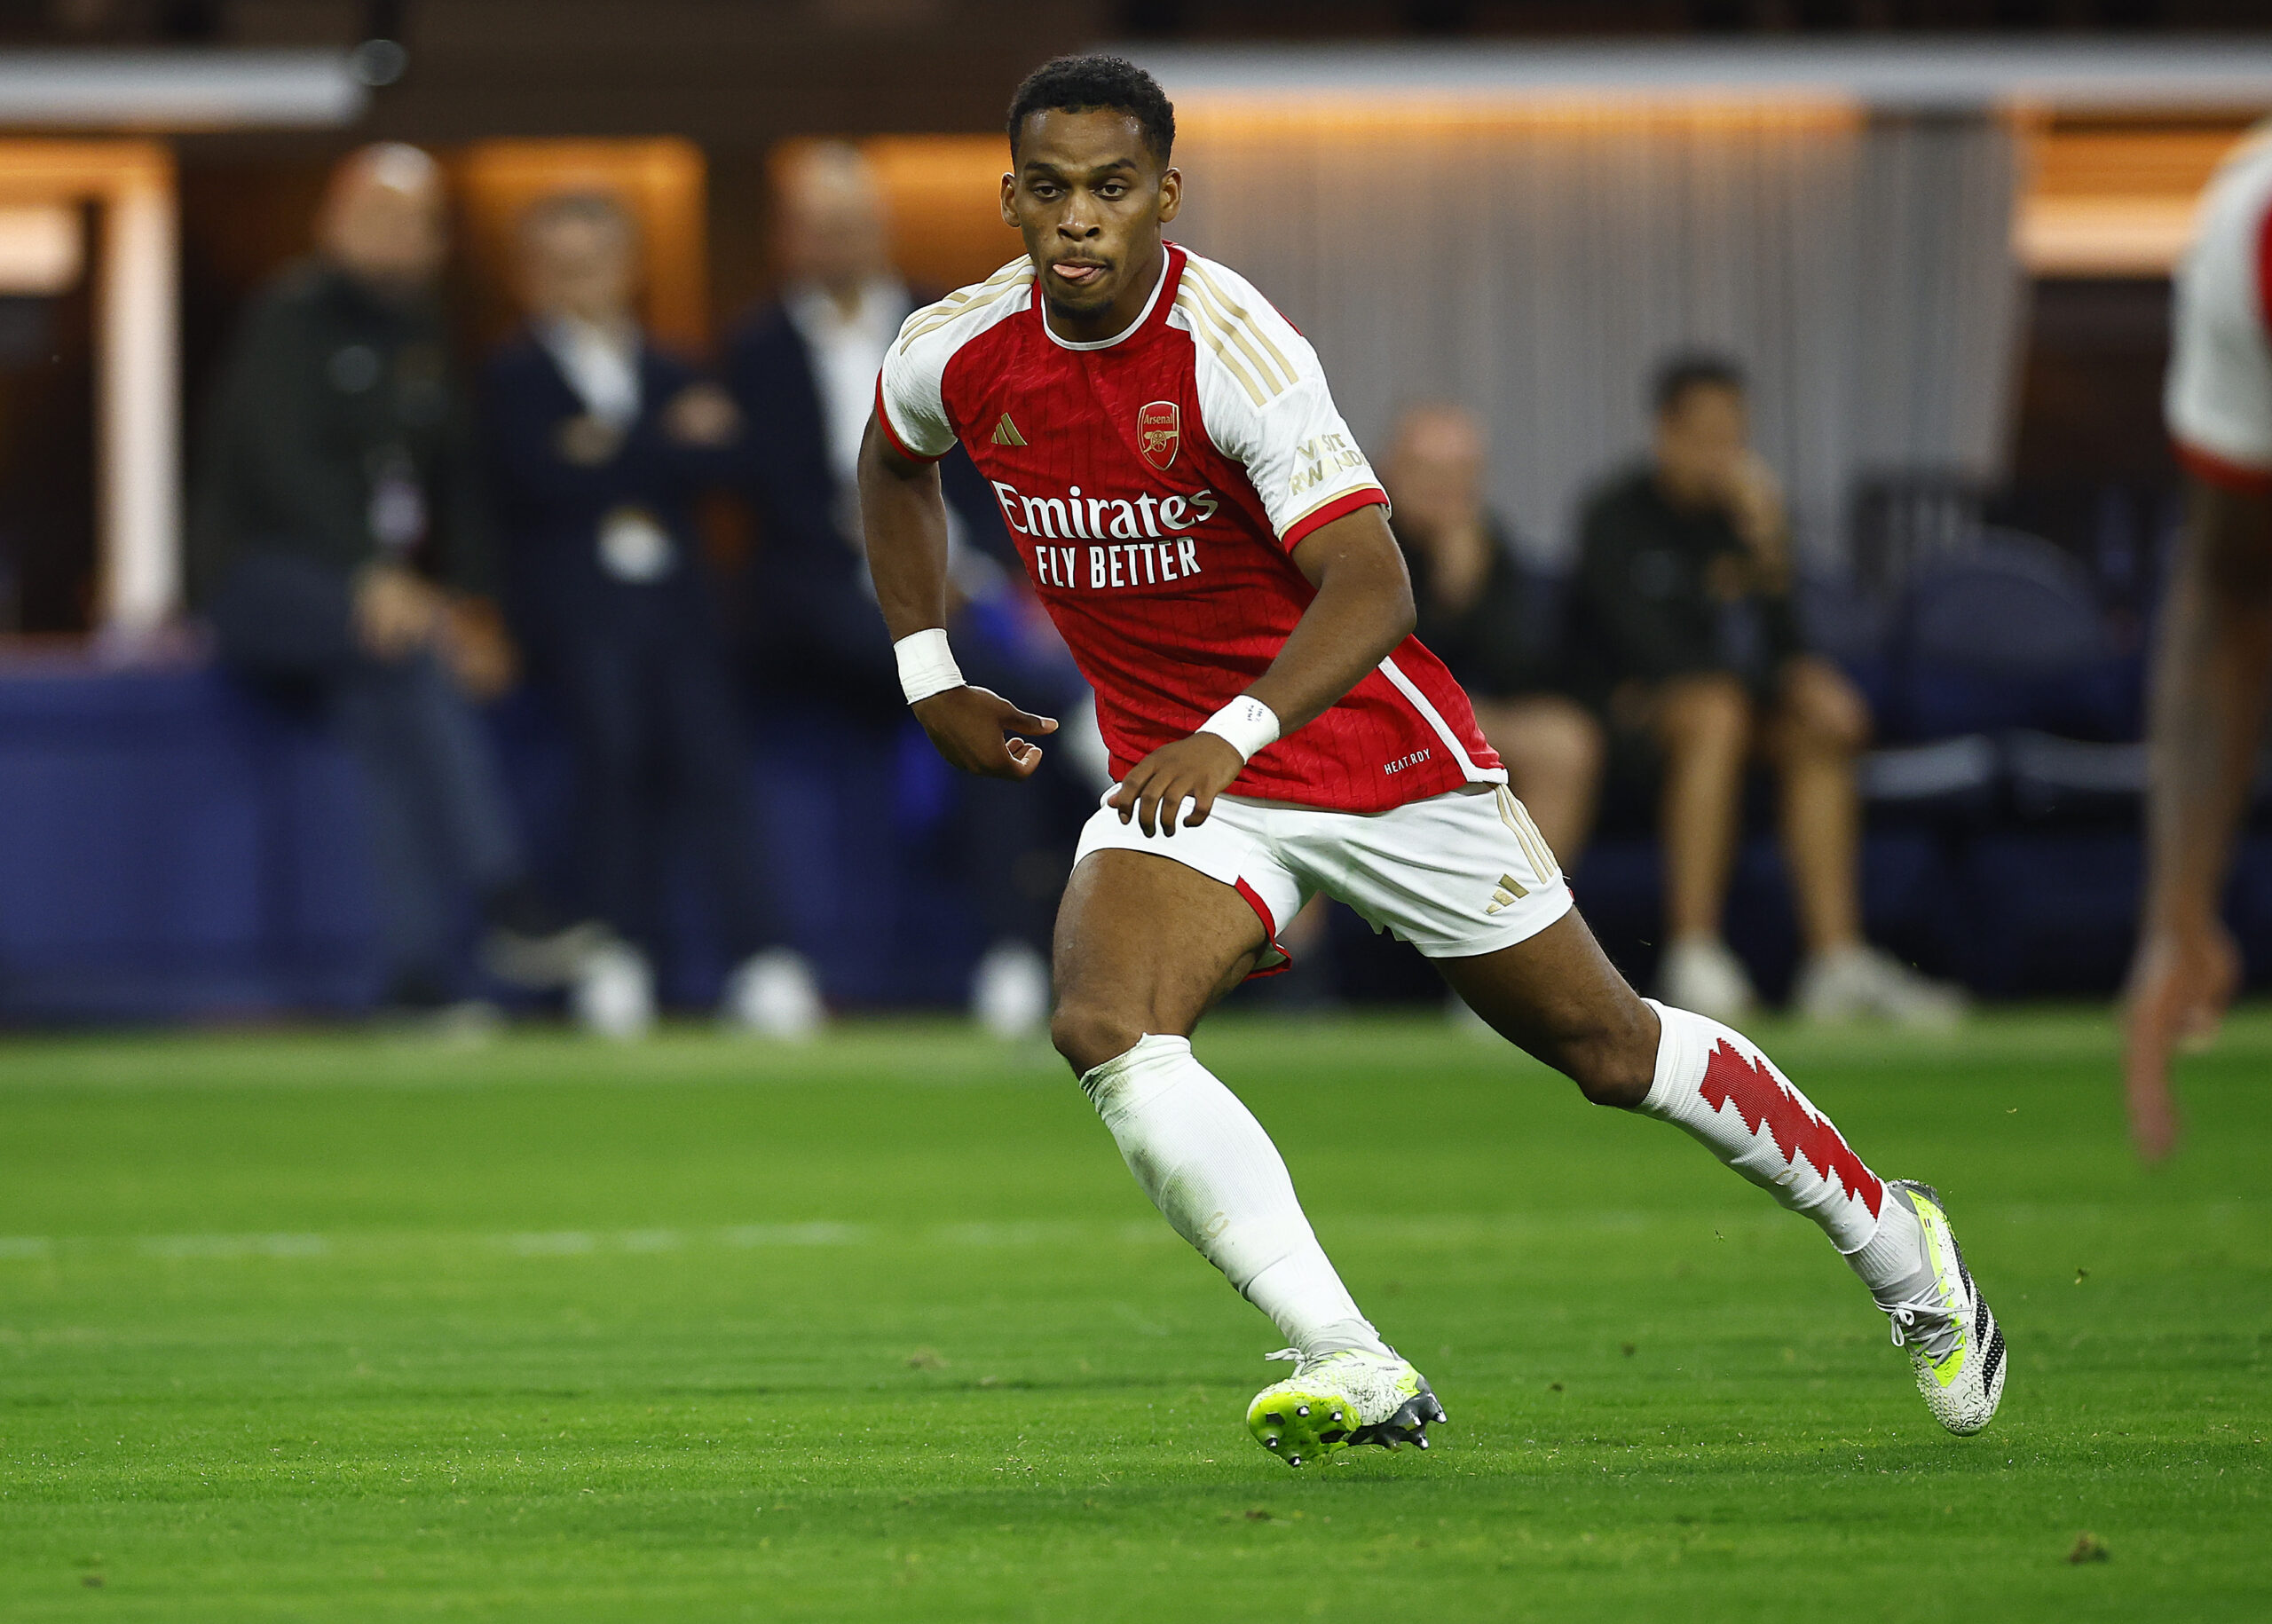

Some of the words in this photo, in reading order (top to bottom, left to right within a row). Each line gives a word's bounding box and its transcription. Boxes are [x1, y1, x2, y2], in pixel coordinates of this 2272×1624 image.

[1143, 413, 1173, 425] Arsenal
[1297, 433, 1346, 460] VISIT
[990, 479, 1219, 540] Emirates
[1035, 545, 1076, 588] FLY
[1089, 535, 1202, 589] BETTER
[1384, 747, 1431, 776] HEAT.RDY
